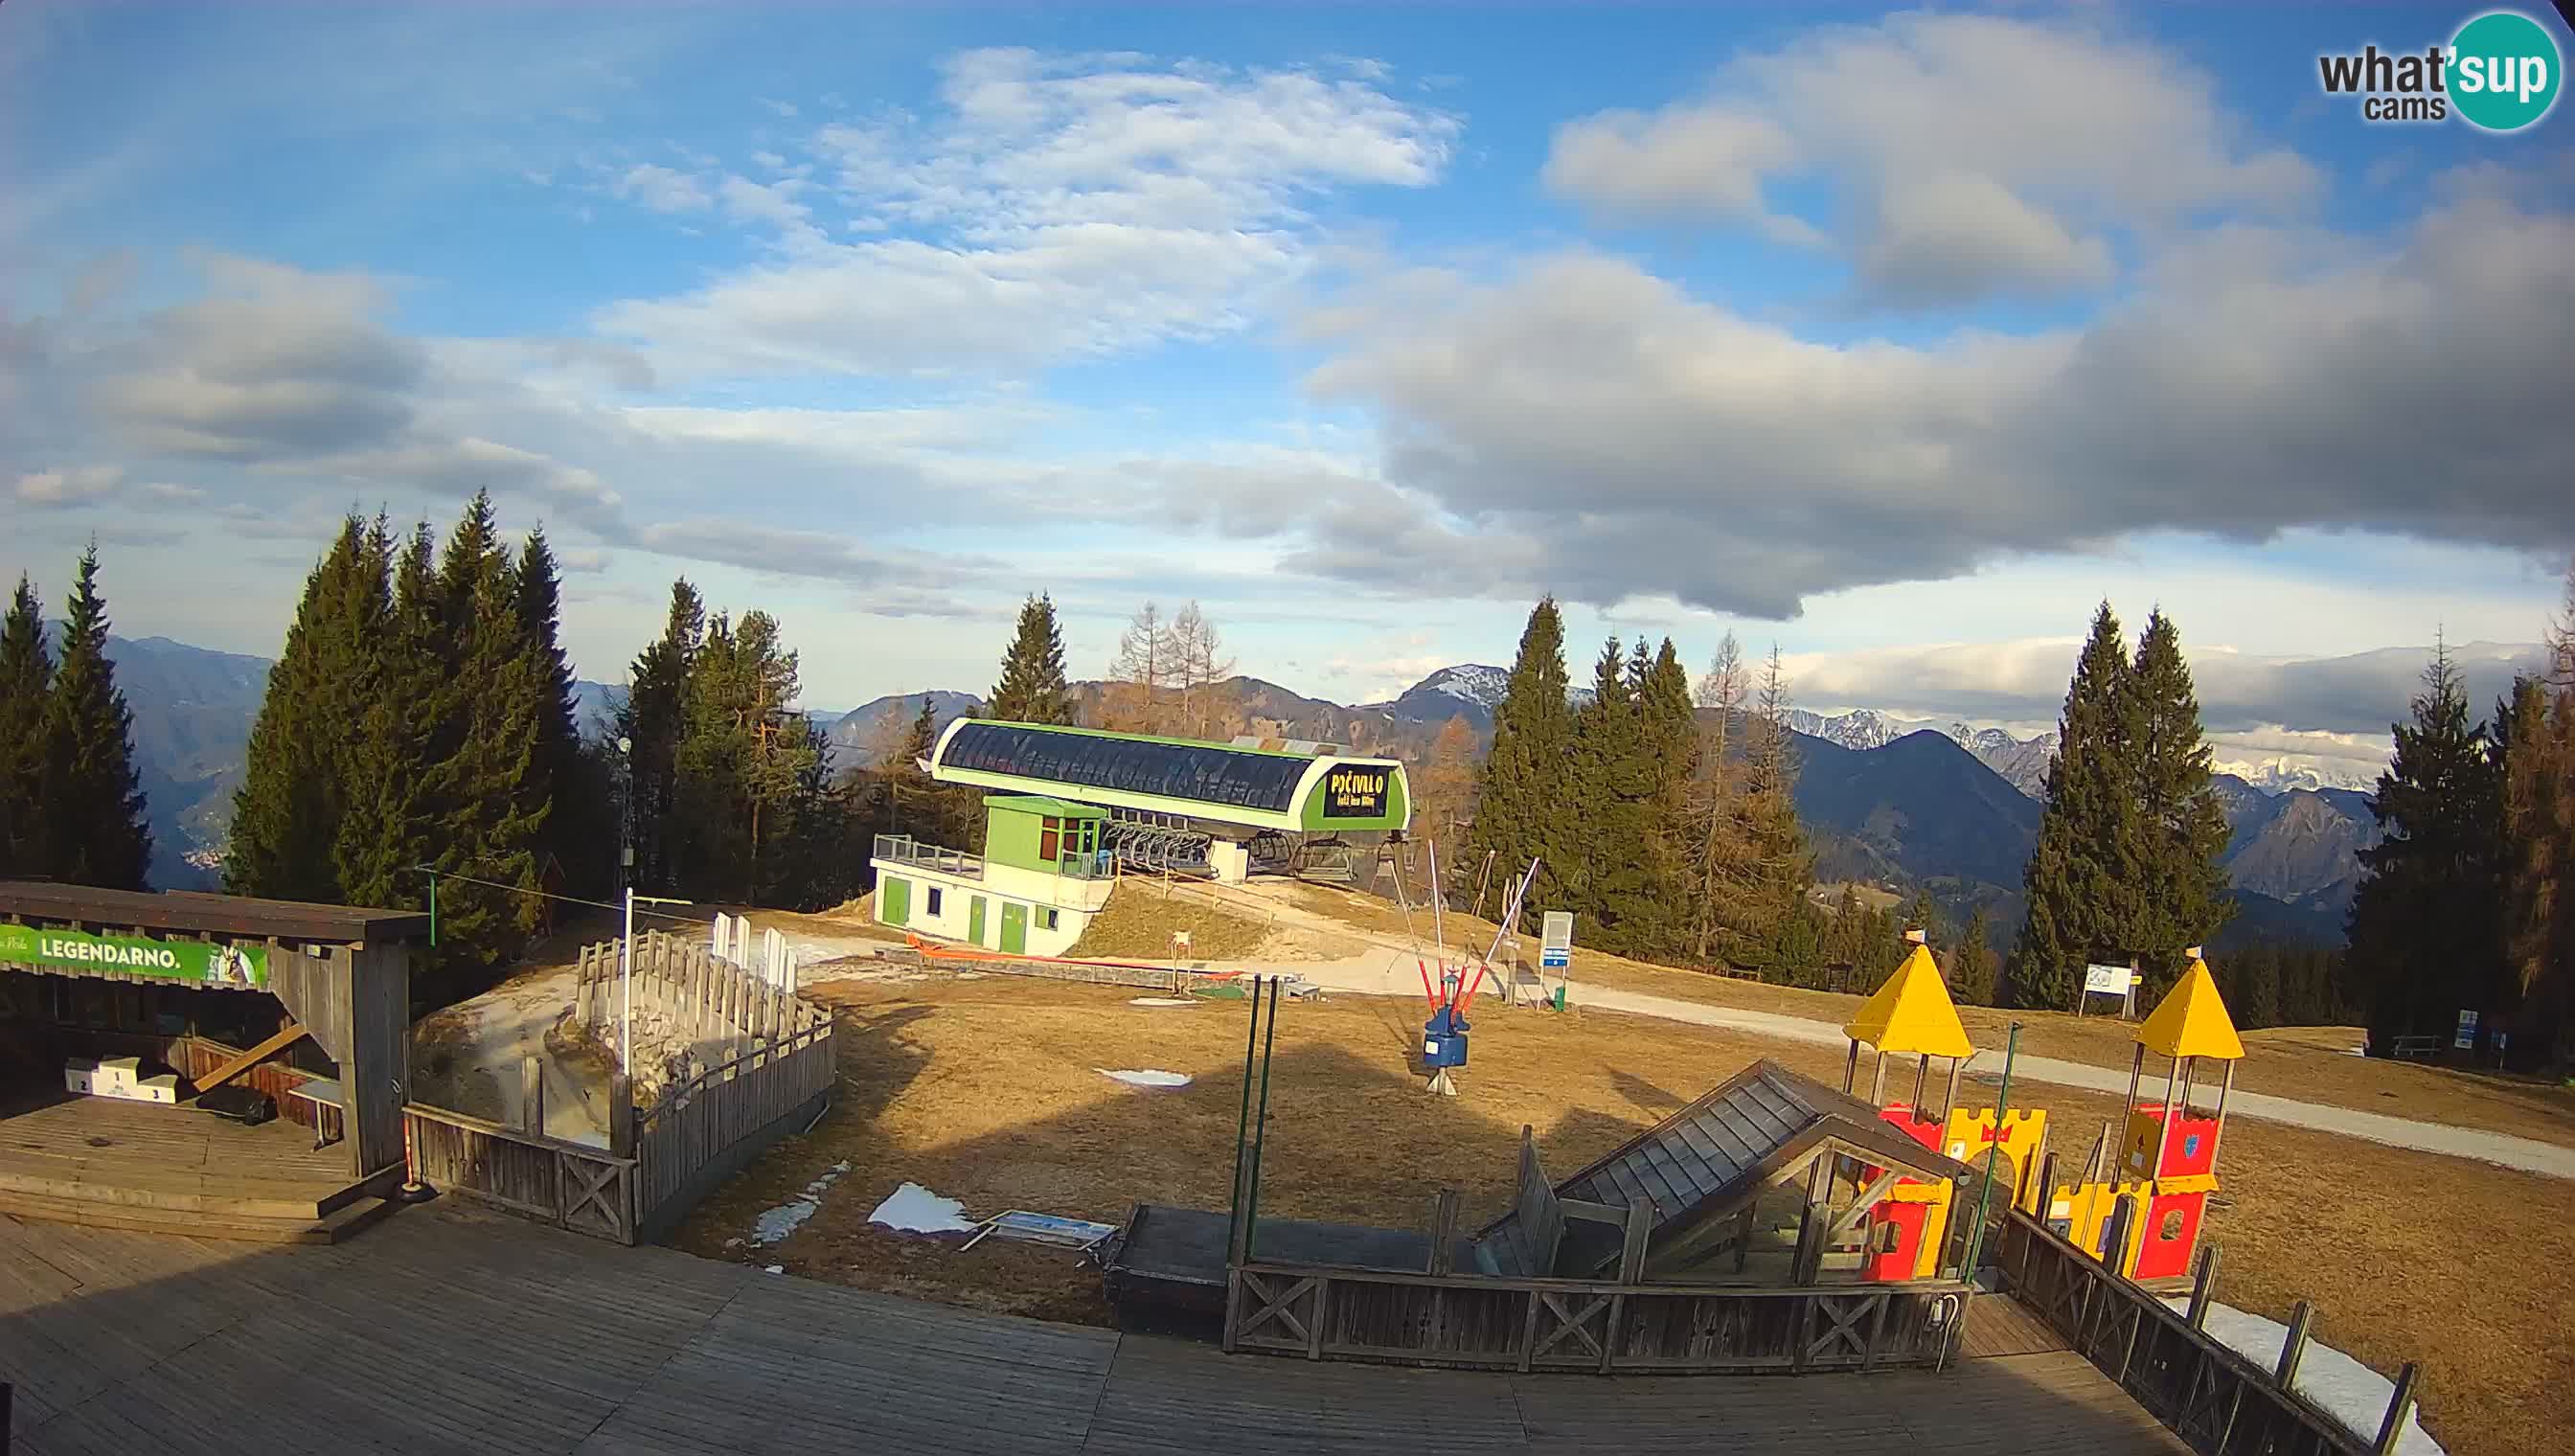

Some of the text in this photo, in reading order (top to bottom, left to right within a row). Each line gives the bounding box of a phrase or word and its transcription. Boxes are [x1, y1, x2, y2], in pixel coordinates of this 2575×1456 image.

[41, 938, 181, 969] LEGENDARNO.
[80, 1080, 87, 1091] 2
[152, 1088, 160, 1100] 3
